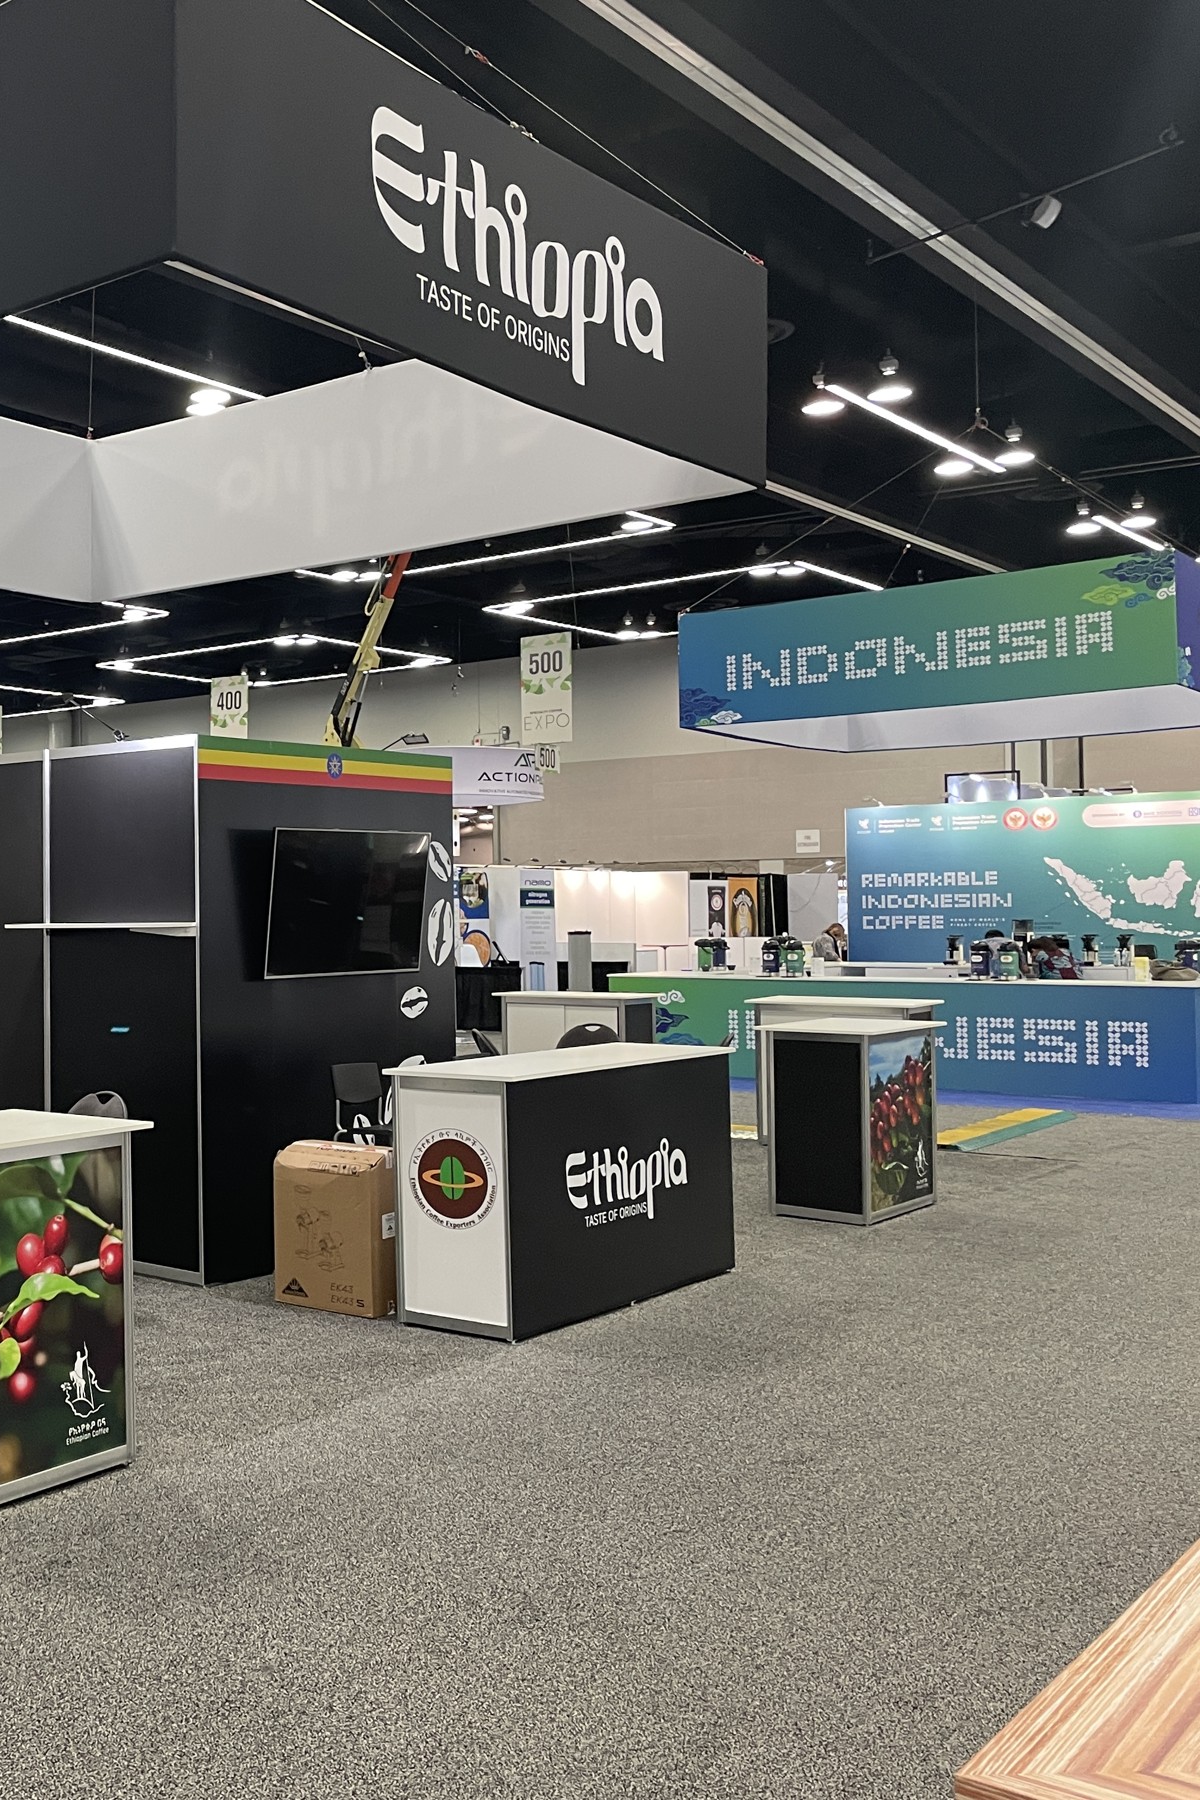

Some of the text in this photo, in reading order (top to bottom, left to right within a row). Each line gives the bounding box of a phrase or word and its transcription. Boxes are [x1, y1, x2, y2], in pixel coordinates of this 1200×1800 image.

[371, 106, 664, 385] Ethiopia
[416, 273, 570, 361] TASTE OF ORIGINS
[726, 610, 1114, 691] INDONESIA
[529, 650, 563, 675] 500
[216, 690, 242, 710] 400
[523, 713, 570, 731] EXPO
[539, 747, 556, 769] 500
[861, 871, 998, 887] REMARKABLE
[862, 893, 1012, 909] INDONESIAN
[862, 915, 944, 930] COFFEE
[565, 1137, 688, 1220] Ethiopia
[426, 1208, 444, 1224] Coffee
[445, 1220, 476, 1229] Exporters
[477, 1185, 496, 1220] Association
[584, 1202, 647, 1227] TASTE OF ORIGINS
[330, 1282, 354, 1294] EK43
[92, 1427, 109, 1437] Coffee
